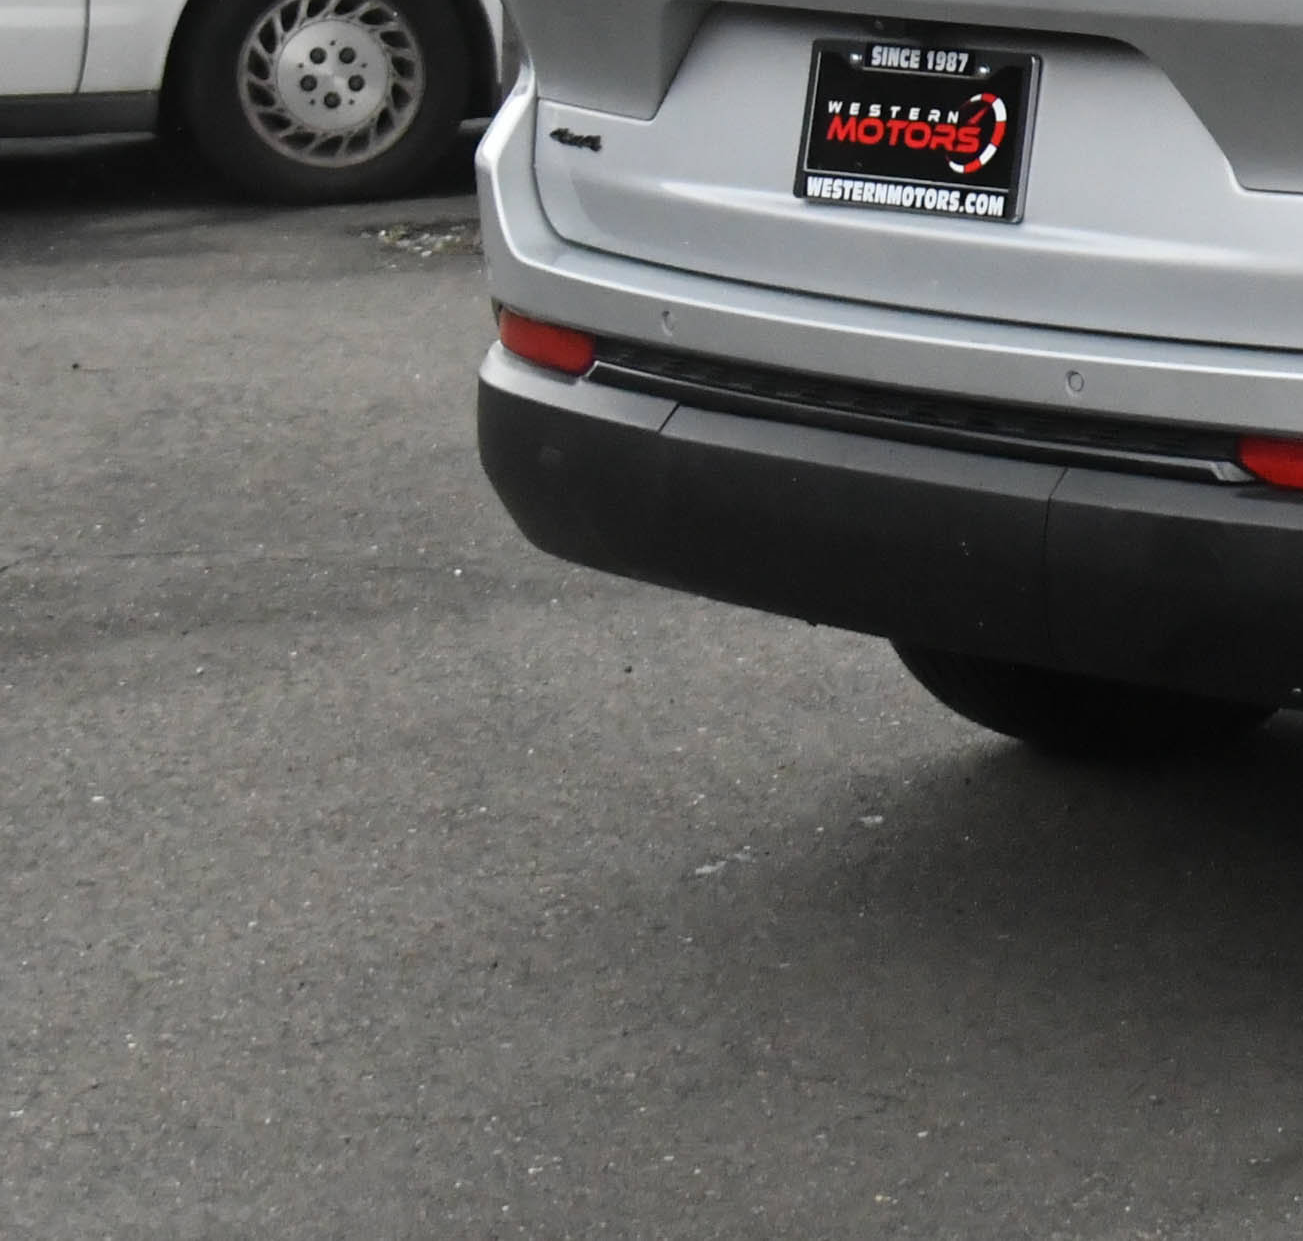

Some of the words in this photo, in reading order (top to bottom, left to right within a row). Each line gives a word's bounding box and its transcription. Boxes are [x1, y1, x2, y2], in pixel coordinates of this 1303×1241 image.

[871, 45, 921, 70] SINCE
[925, 51, 970, 74] 1987
[827, 100, 959, 124] WESTERN
[826, 114, 981, 153] MOTORS
[806, 175, 1006, 218] WESTERNMOTORS.COM
